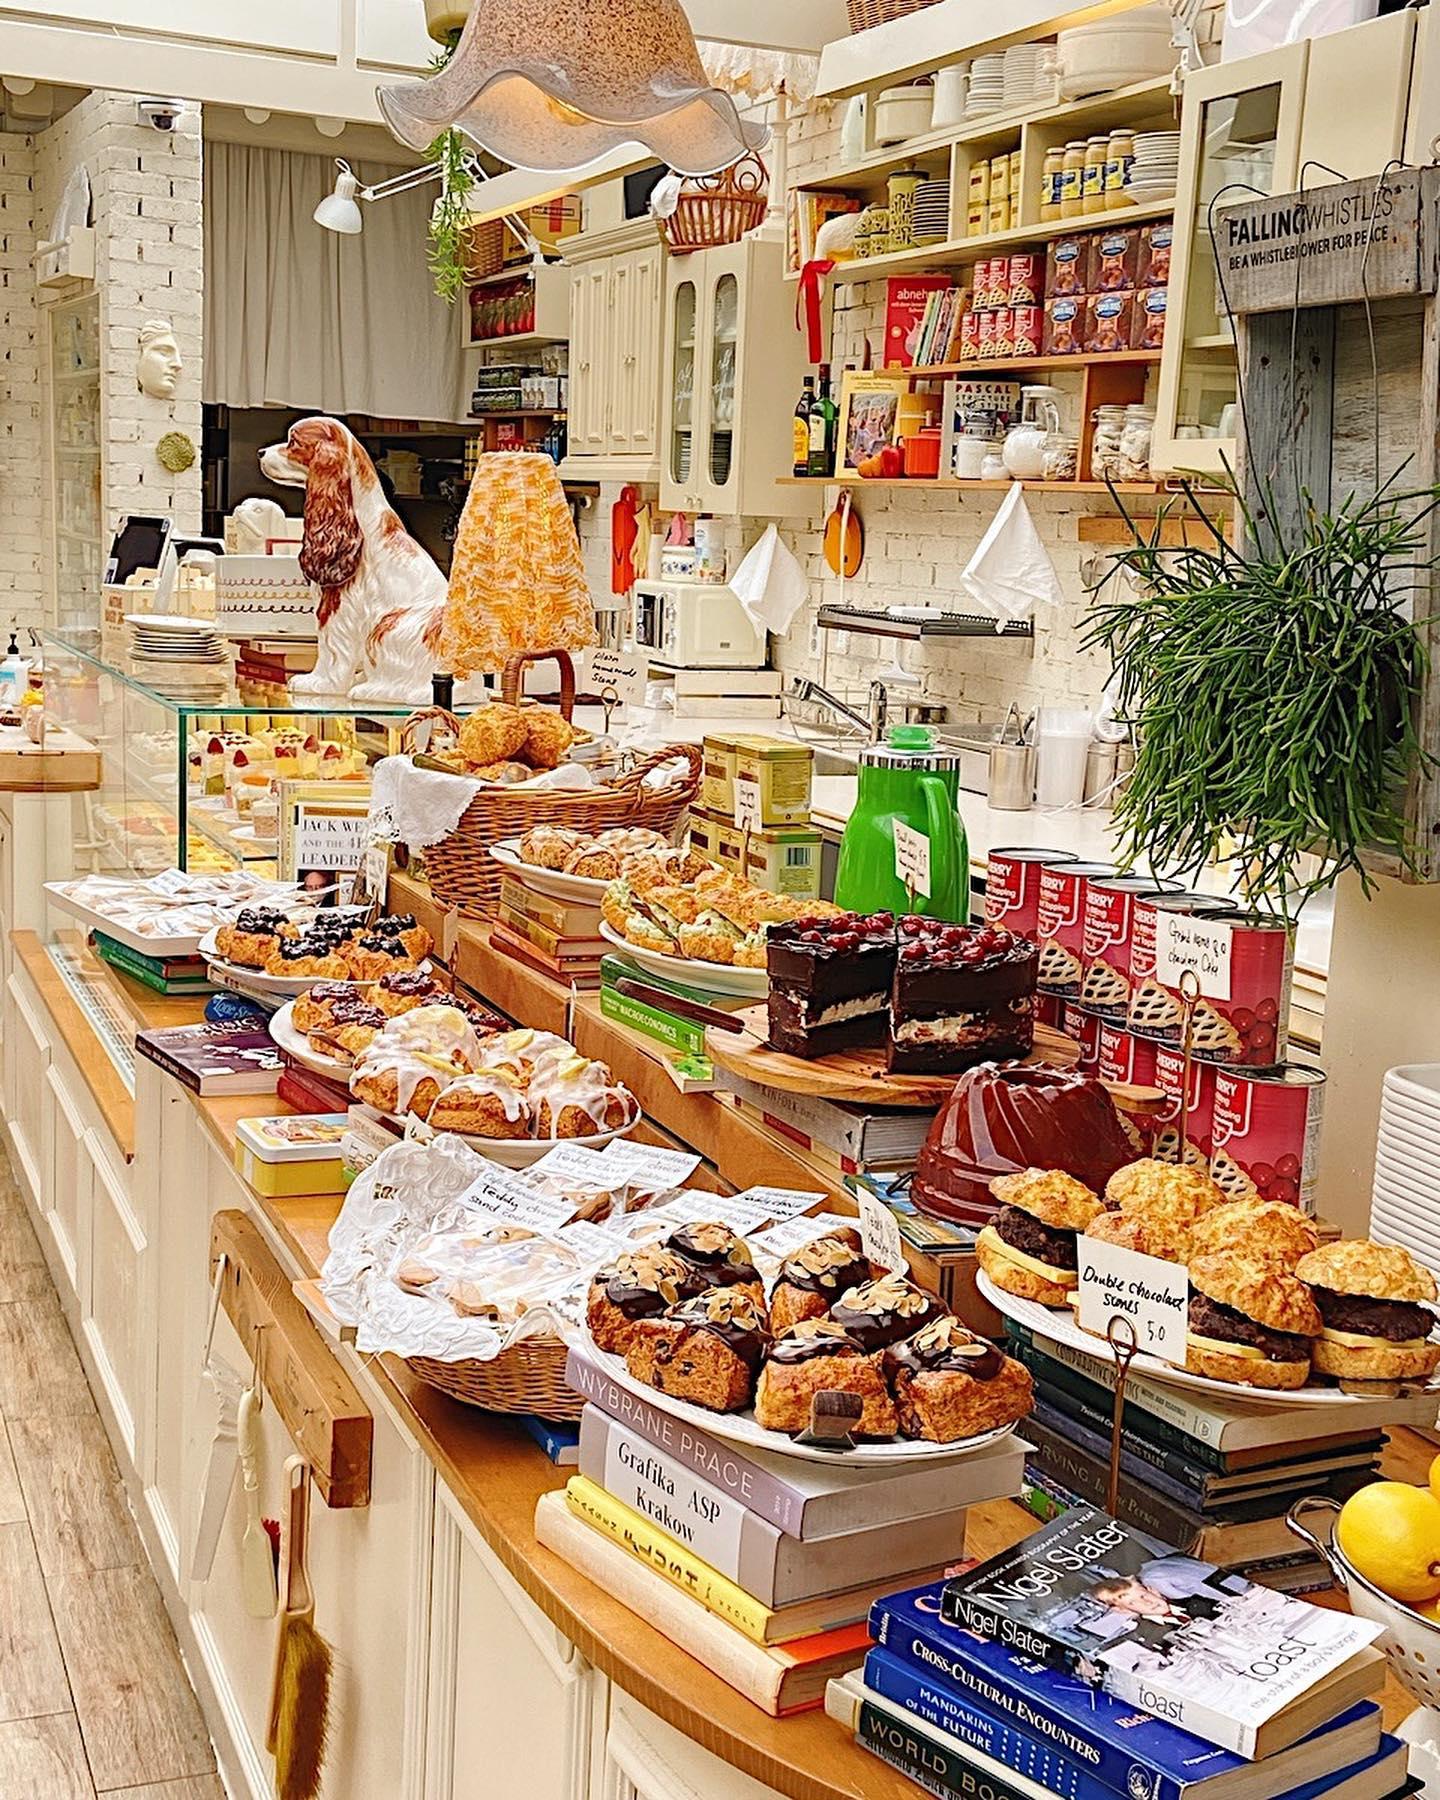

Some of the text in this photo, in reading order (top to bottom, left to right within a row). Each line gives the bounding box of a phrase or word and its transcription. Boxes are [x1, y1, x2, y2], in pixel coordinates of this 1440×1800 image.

[1229, 187, 1393, 247] FALLING WHISTLES
[1229, 255, 1240, 271] BE
[1332, 233, 1353, 251] FOR
[896, 288, 928, 300] abneh
[955, 383, 1011, 394] PASCAL
[302, 838, 322, 848] AND
[326, 838, 342, 849] THE
[303, 819, 337, 832] JACK
[302, 853, 359, 867] LEADER
[482, 1184, 519, 1212] Teddy
[1082, 1265, 1185, 1312] Double chocolate
[576, 1363, 754, 1499] WYBRANE PRACE
[618, 1441, 676, 1498] Grafika
[688, 1490, 722, 1525] ASP
[1038, 1442, 1089, 1483] IRVING
[635, 1486, 696, 1543] Krakow
[624, 1529, 699, 1592] FLUSH
[976, 1519, 1130, 1612] Nigel Slater
[954, 1597, 1052, 1659] Nigel Slater
[1237, 1633, 1317, 1683] toast
[919, 1688, 994, 1736] MANDARINS
[1115, 1713, 1155, 1730] Rich
[1138, 1683, 1185, 1724] toast
[943, 1716, 993, 1751] FUTURE
[1017, 1703, 1101, 1765] ENCOUNTERS
[869, 1716, 948, 1776] WORLD
[961, 1771, 1011, 1800] BO
